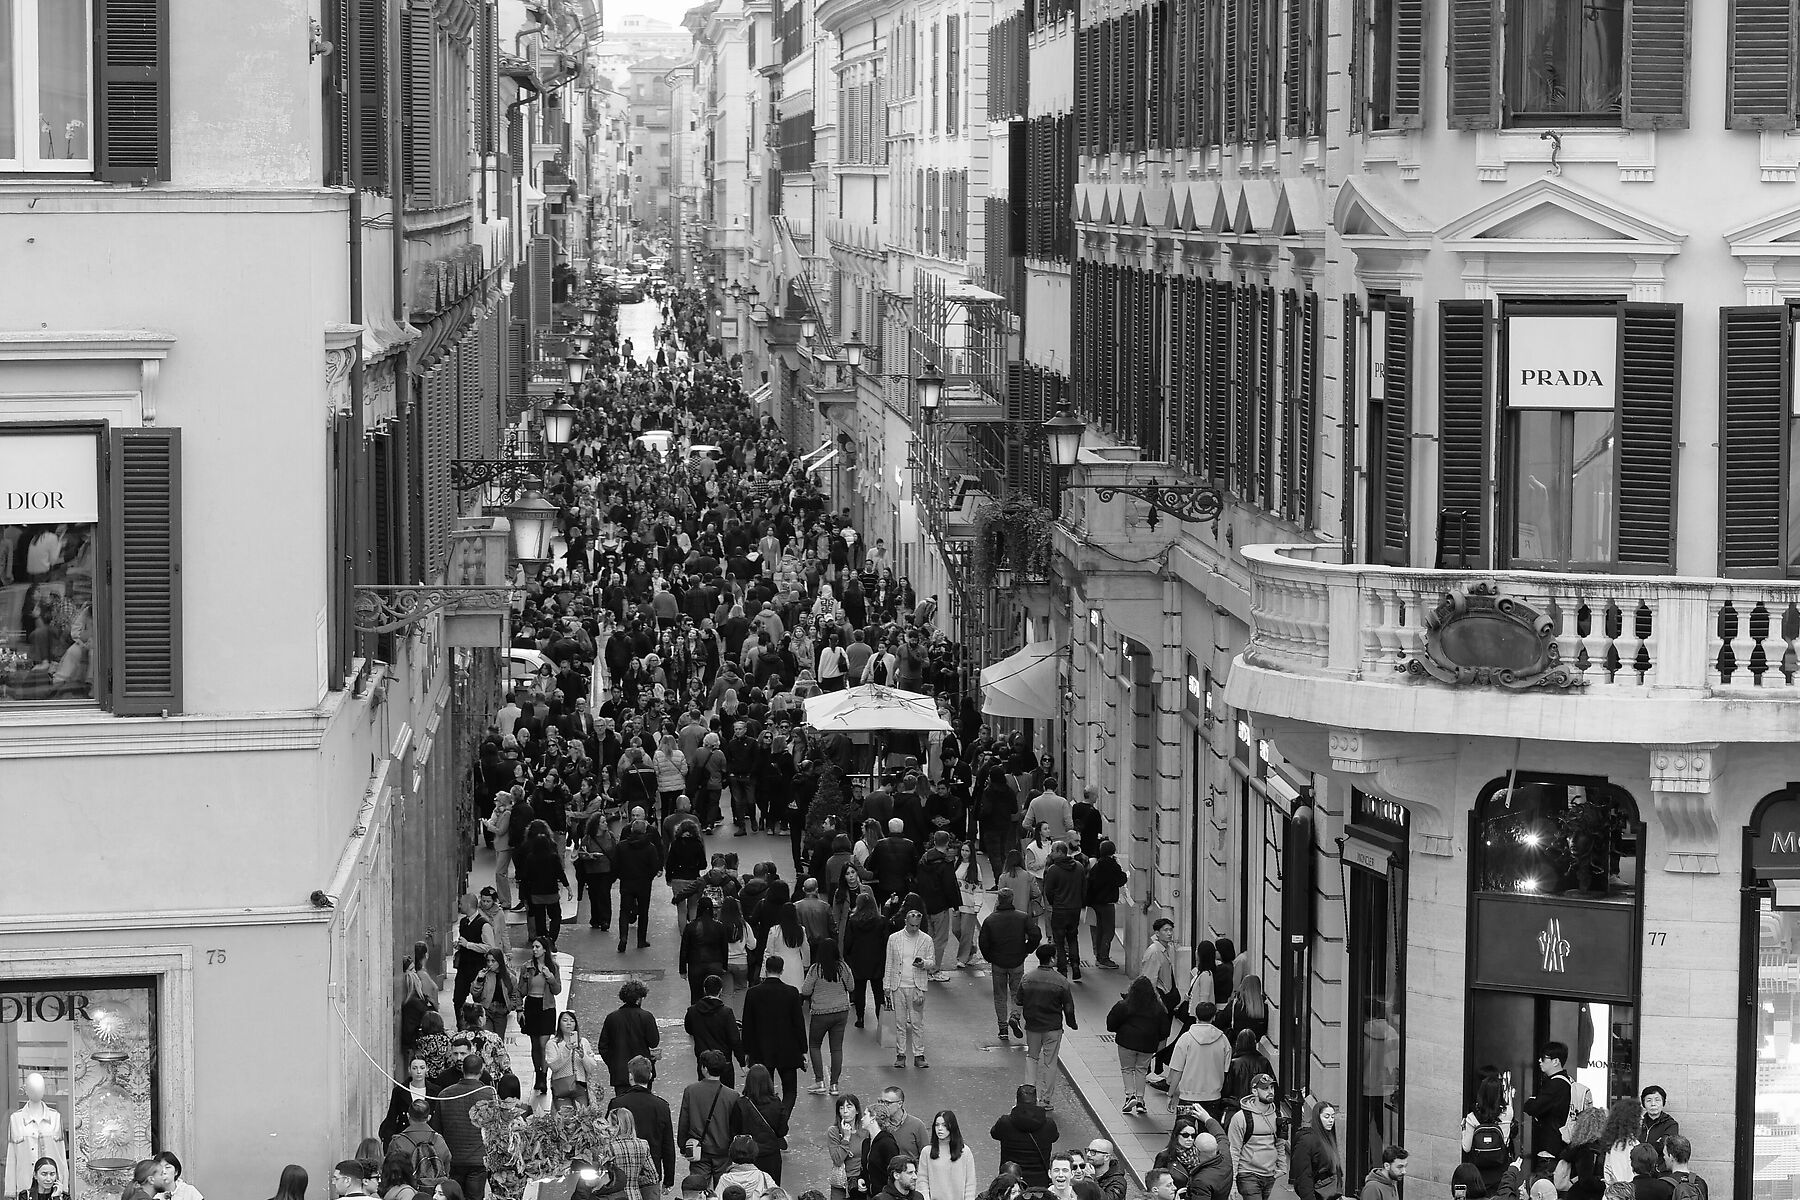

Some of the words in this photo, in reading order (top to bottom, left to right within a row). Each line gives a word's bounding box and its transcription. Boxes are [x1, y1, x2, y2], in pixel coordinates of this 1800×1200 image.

[1521, 369, 1604, 387] PRADA
[7, 491, 65, 510] DIOR
[1648, 931, 1667, 946] 77
[206, 949, 227, 965] 75
[0, 994, 94, 1024] DIOR
